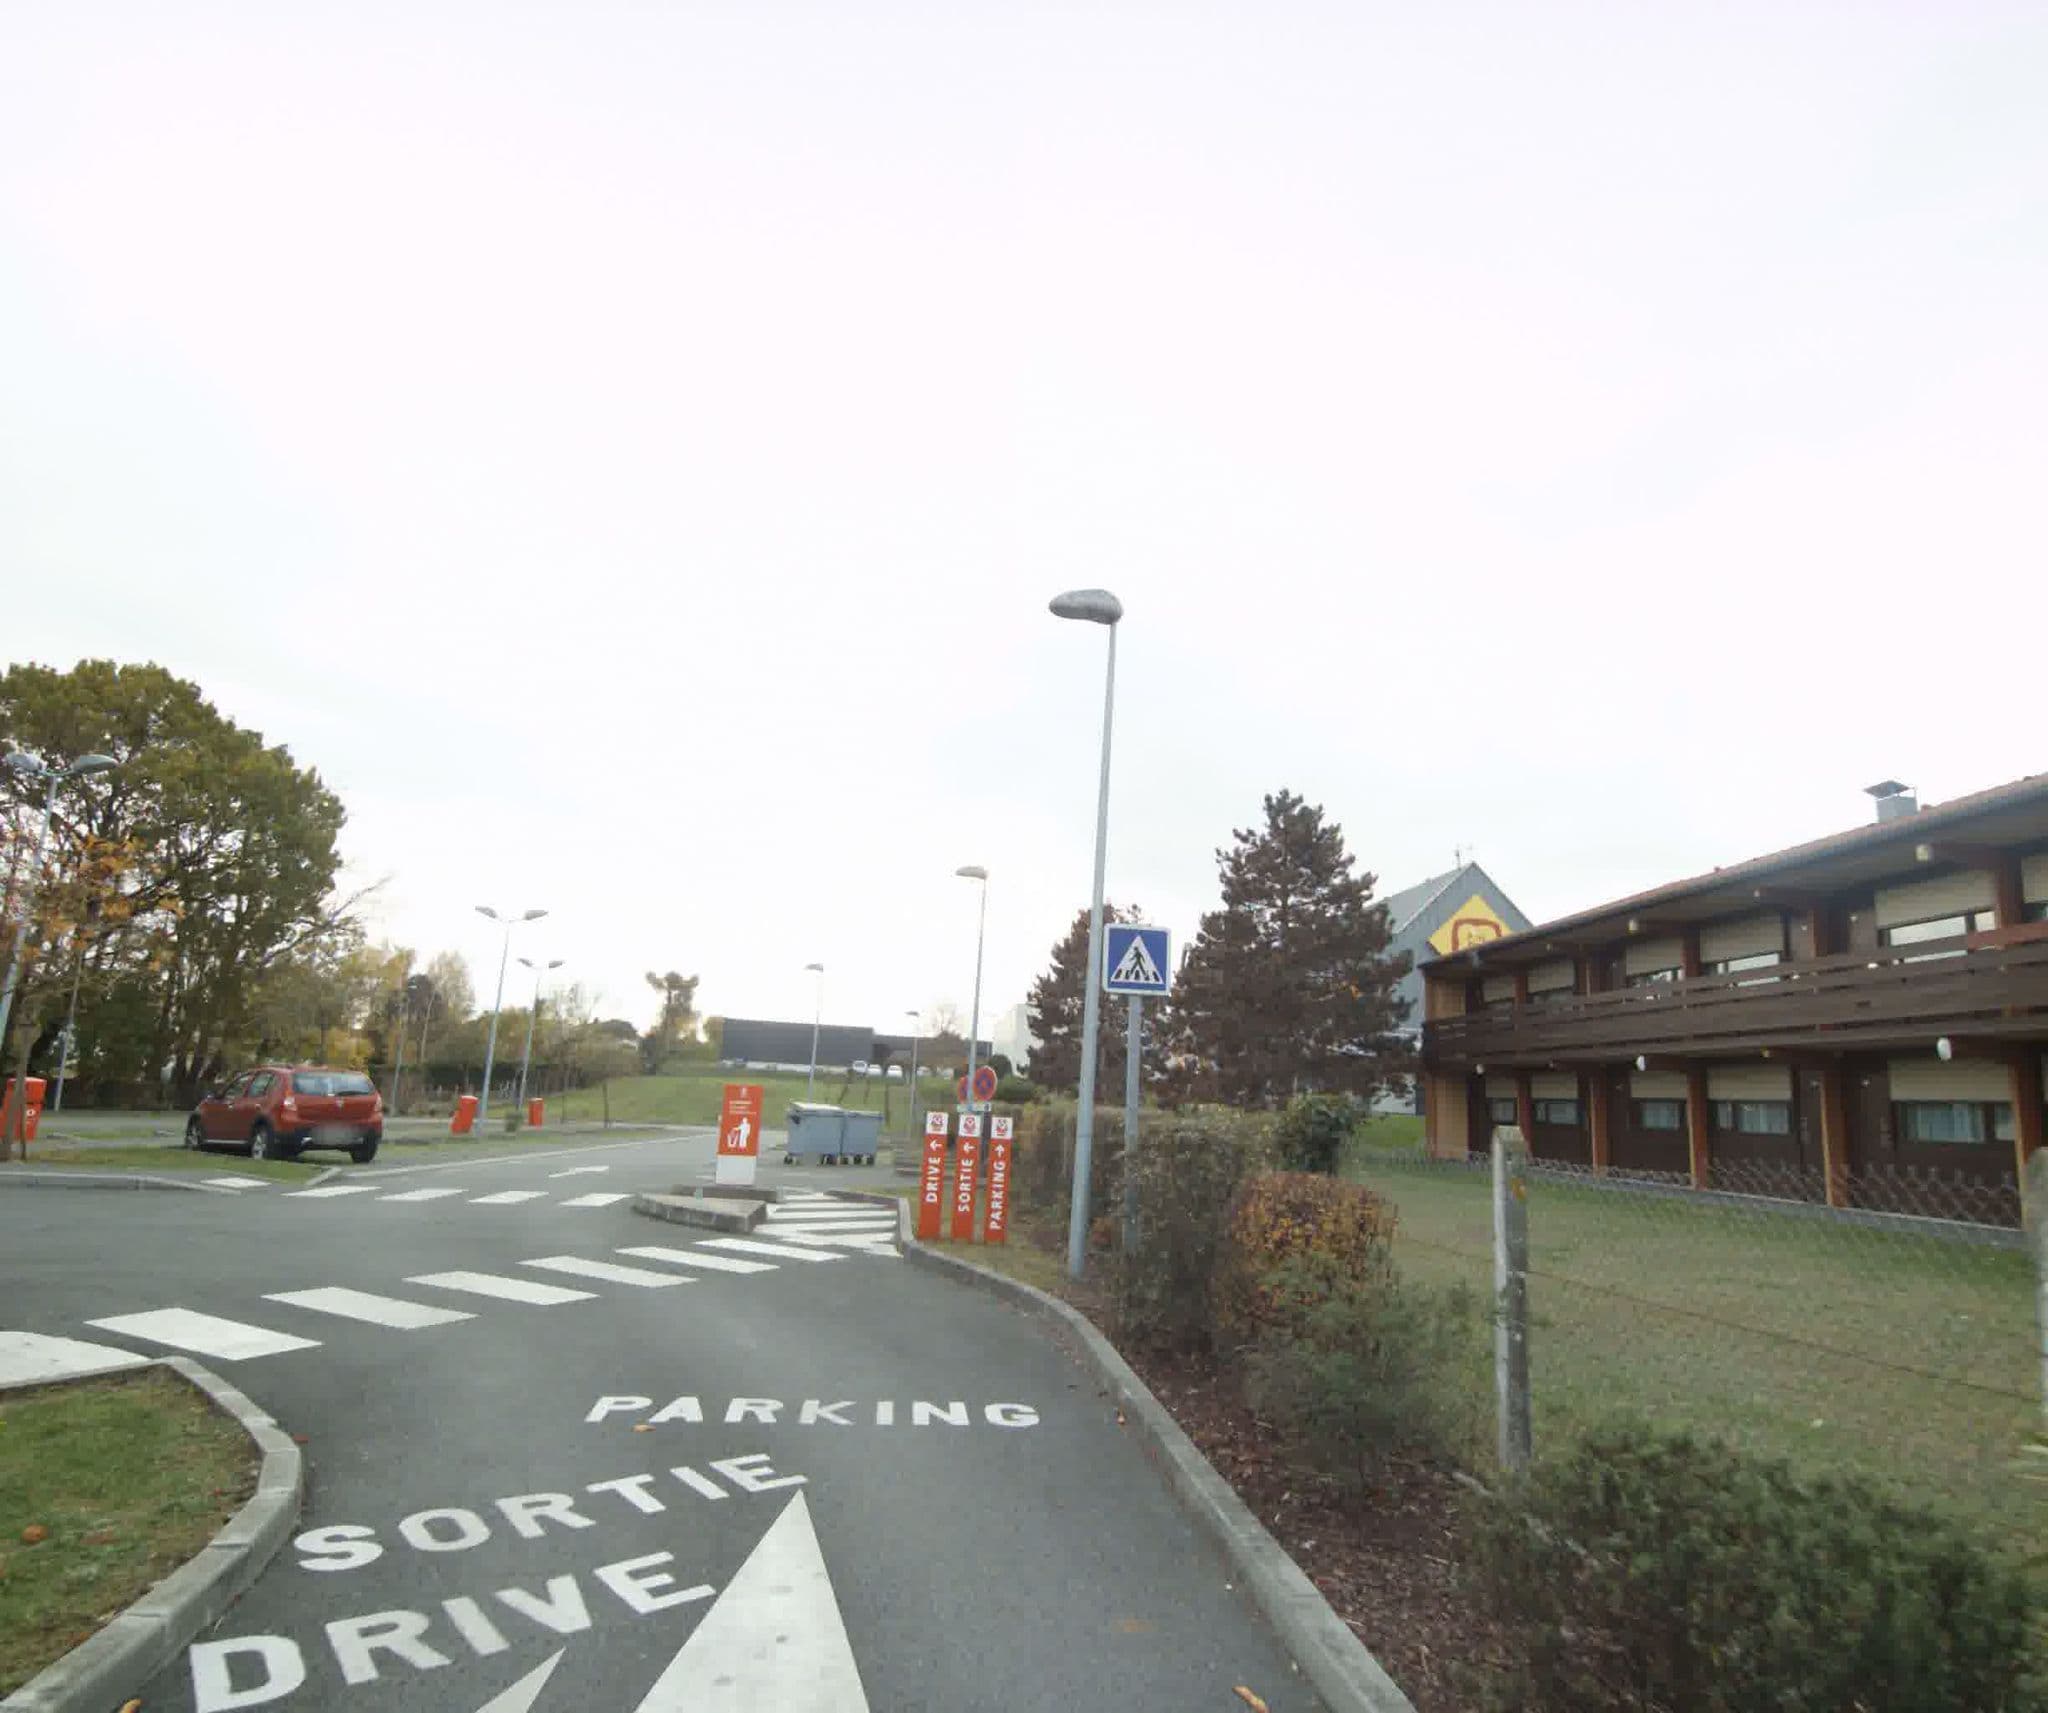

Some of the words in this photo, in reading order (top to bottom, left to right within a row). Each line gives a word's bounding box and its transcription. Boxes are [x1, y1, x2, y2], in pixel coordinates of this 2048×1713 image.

[925, 1157, 941, 1203] DRIVE
[958, 1159, 974, 1212] SORTIE
[990, 1161, 1006, 1230] PARKING
[585, 1396, 1042, 1429] PARKING
[293, 1453, 808, 1572] SORTIE
[189, 1551, 716, 1713] DRIVE
